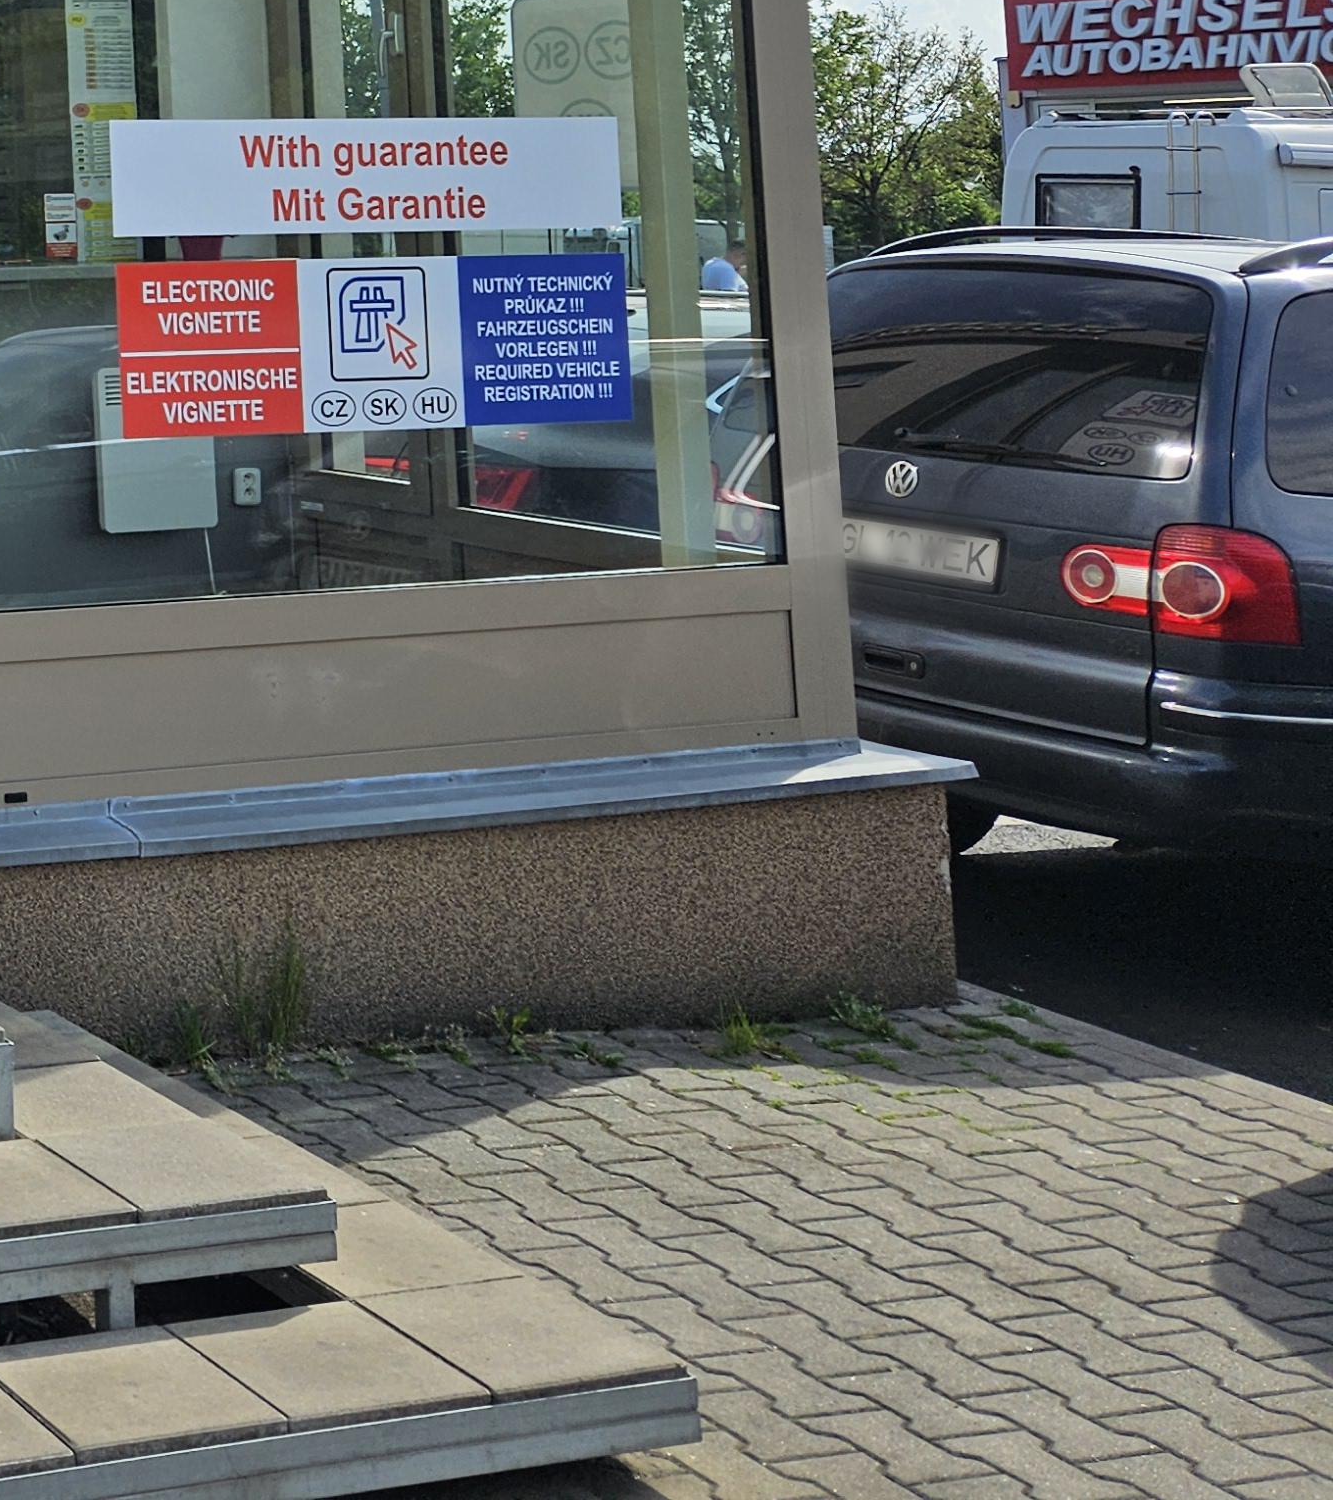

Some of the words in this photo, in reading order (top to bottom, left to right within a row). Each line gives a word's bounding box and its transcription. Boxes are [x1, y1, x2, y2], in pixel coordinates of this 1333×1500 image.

[239, 135, 321, 168] With
[333, 134, 508, 176] guarantee
[272, 188, 326, 222] Mit
[337, 186, 486, 221] Garantie
[142, 278, 275, 304] ELECTRONIC
[472, 273, 524, 293] NUTNÝ
[527, 271, 613, 292] TECHNICKÝ
[504, 294, 567, 315] PRŮKAZ
[157, 310, 261, 335] VIGNETTE
[477, 318, 613, 338] FAHRZEUGSCHEIN
[495, 341, 579, 359] VORLEGEN
[126, 367, 298, 395] ELEKTRONISCHE
[474, 363, 554, 381] REQUIRED
[556, 361, 621, 378] VEHICLE
[484, 383, 595, 403] REGISTRATION
[162, 399, 264, 424] VIGNETTE
[320, 399, 348, 418] CZ
[370, 397, 399, 416] SK
[421, 395, 450, 415] HU
